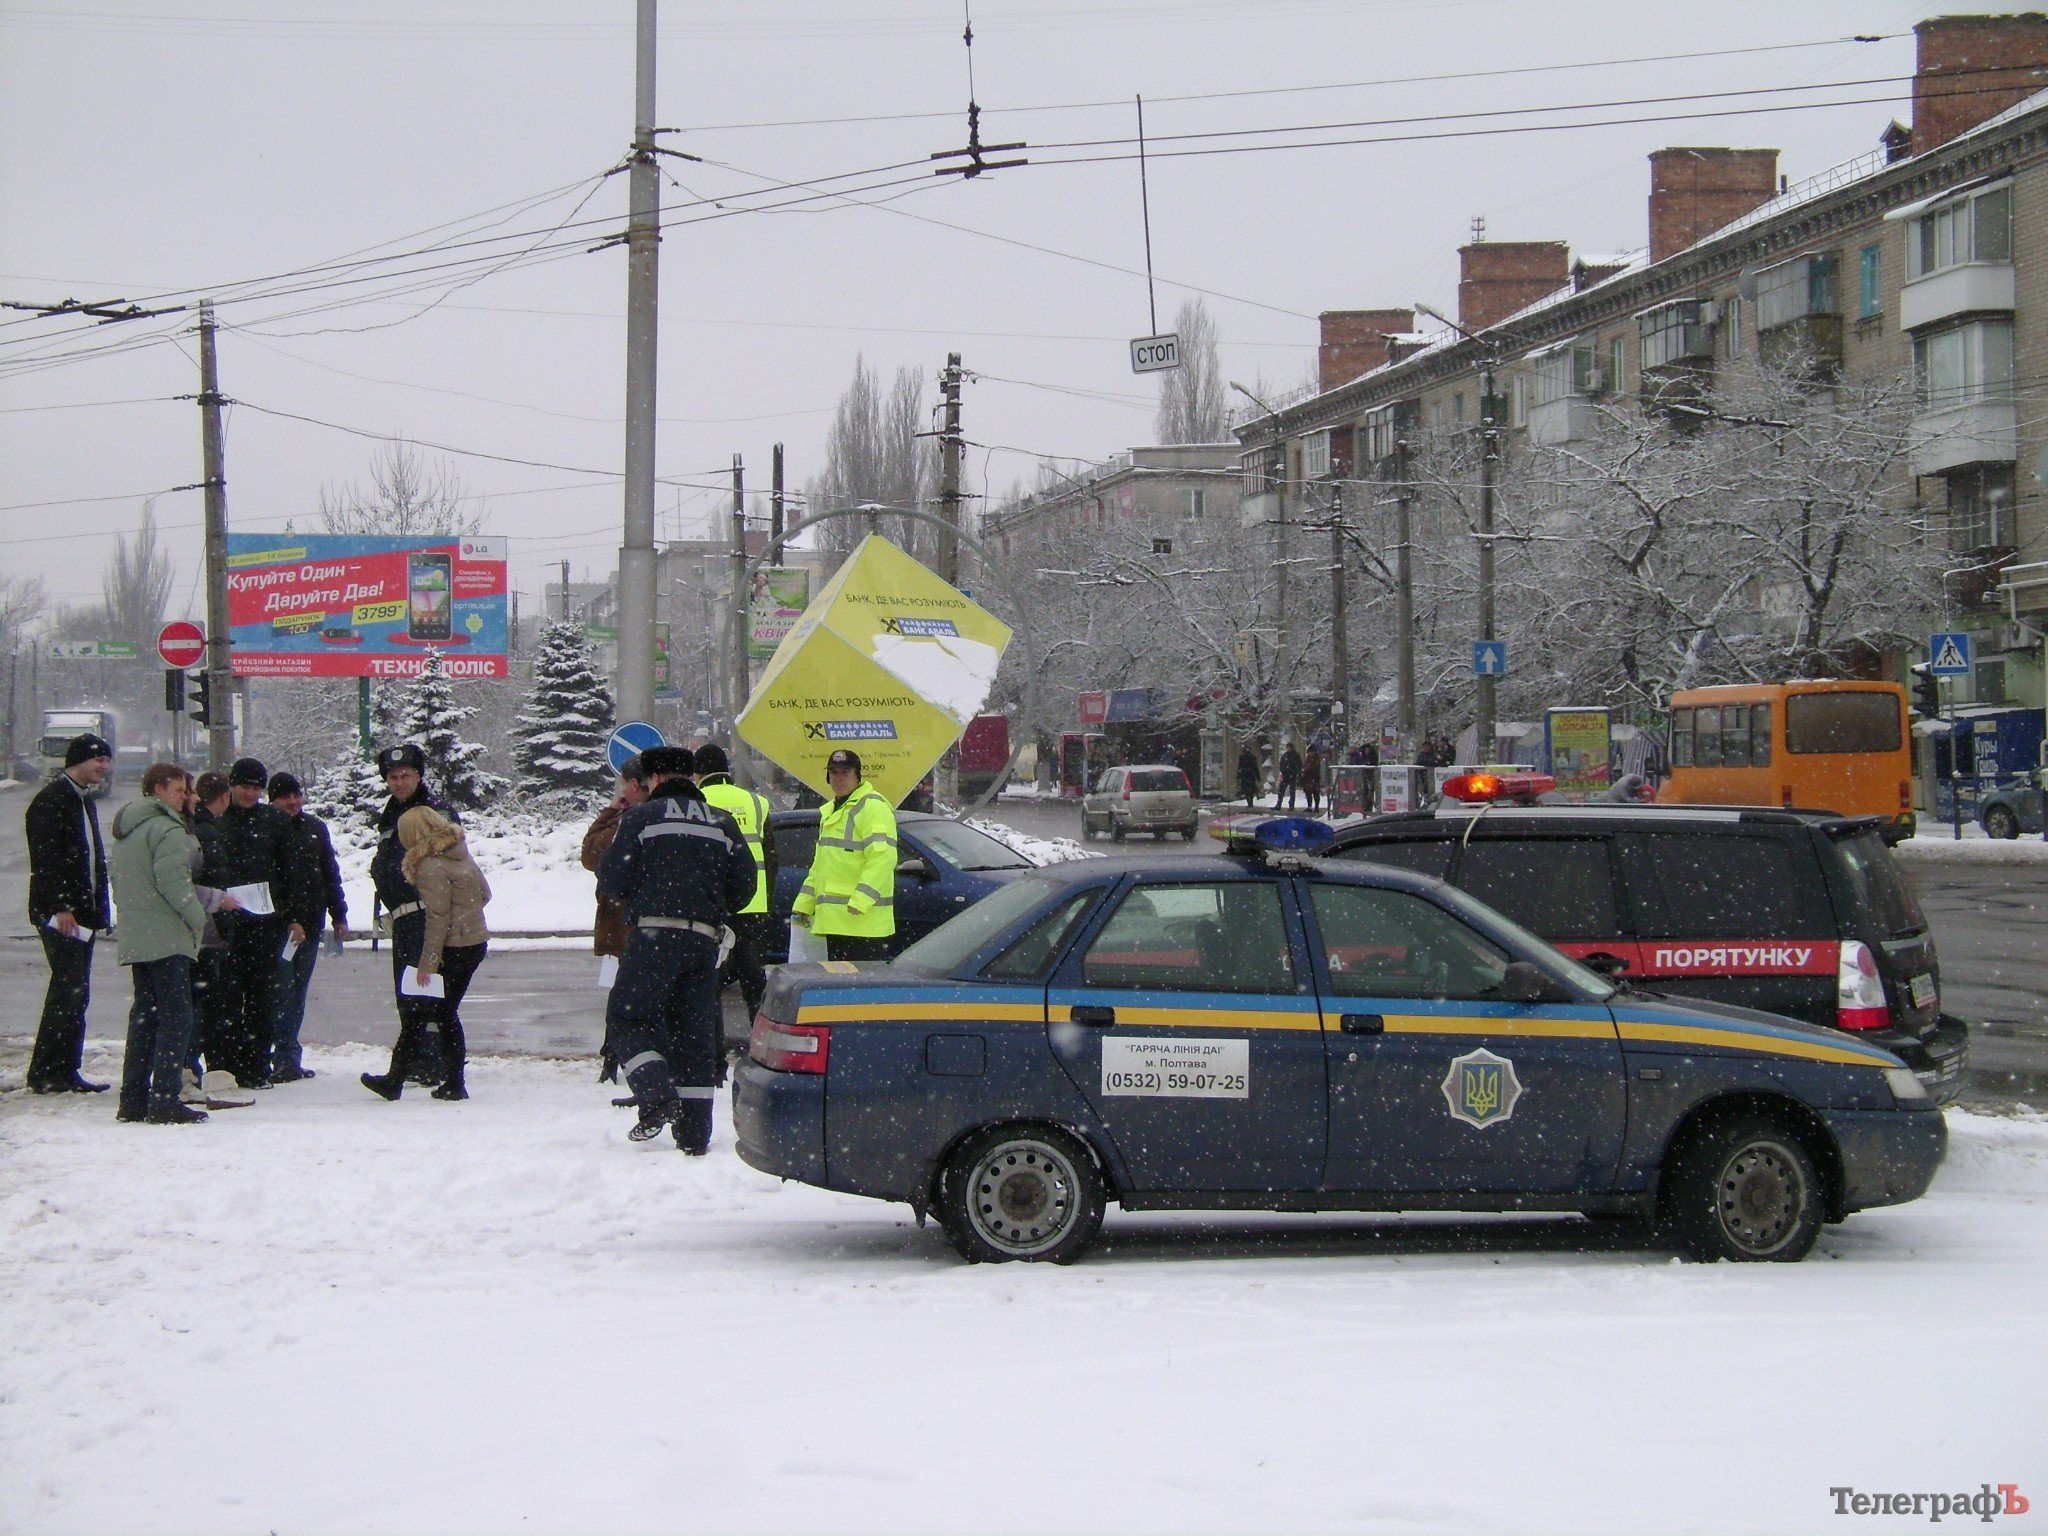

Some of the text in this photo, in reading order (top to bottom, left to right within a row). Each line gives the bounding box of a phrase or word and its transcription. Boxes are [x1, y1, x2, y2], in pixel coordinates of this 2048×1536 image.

[1137, 343, 1175, 363] СТОП
[475, 545, 488, 553] LG
[227, 571, 296, 592] Купуйте
[300, 565, 346, 581] Один
[264, 580, 384, 612] Даруйте Два!
[845, 594, 966, 609] БАНК, ДЕ ВАС РОЗУМІЮТЬ
[275, 612, 321, 625] ПОДАРУНОК
[903, 626, 956, 636] БАНК АВАЛЬ
[276, 658, 312, 666] МАГАЗИН
[769, 697, 915, 709] БАНК, ДЕ ВАС РОЗУМІЮТЬ
[830, 729, 893, 738] БАНК АВАЛЬ
[1974, 736, 1998, 758] Куры
[1655, 947, 1812, 968] ПОРЯТУНКУ
[1125, 1044, 1171, 1054] "ГАРЯЧА
[1173, 1045, 1201, 1054] ЛІНІЯ
[1145, 1058, 1207, 1069] м. Полтава
[1106, 1073, 1245, 1092] (0532) 59-07-25
